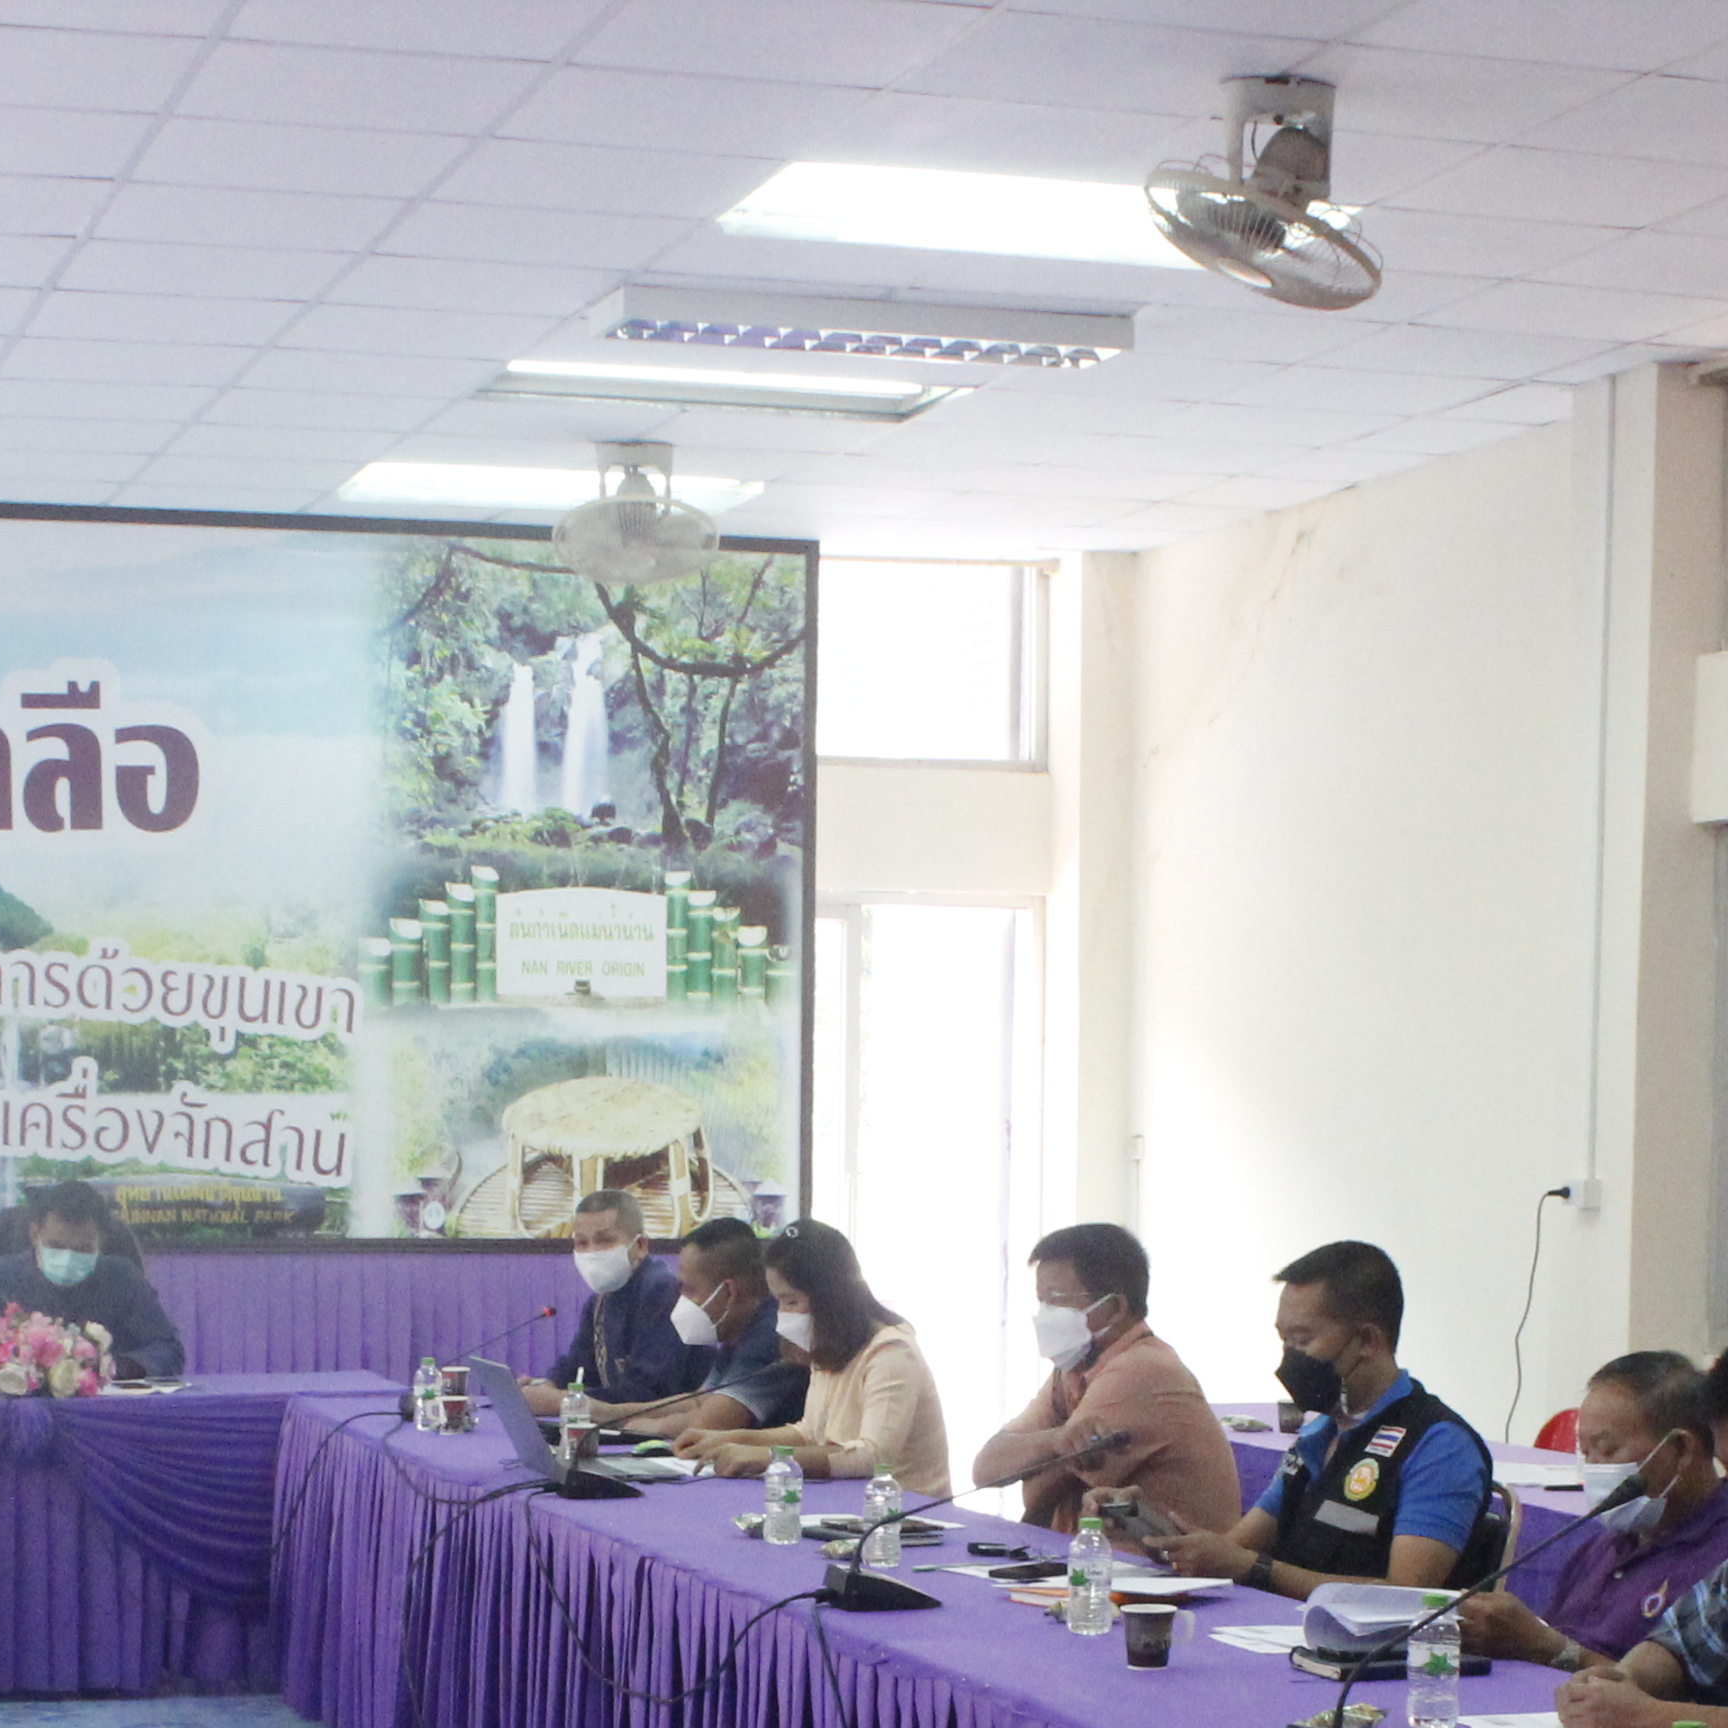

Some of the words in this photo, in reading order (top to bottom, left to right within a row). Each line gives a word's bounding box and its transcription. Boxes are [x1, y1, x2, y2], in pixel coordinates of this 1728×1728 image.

[521, 960, 548, 975] NAN
[556, 961, 592, 976] RIVER
[602, 962, 645, 976] ORIGIN
